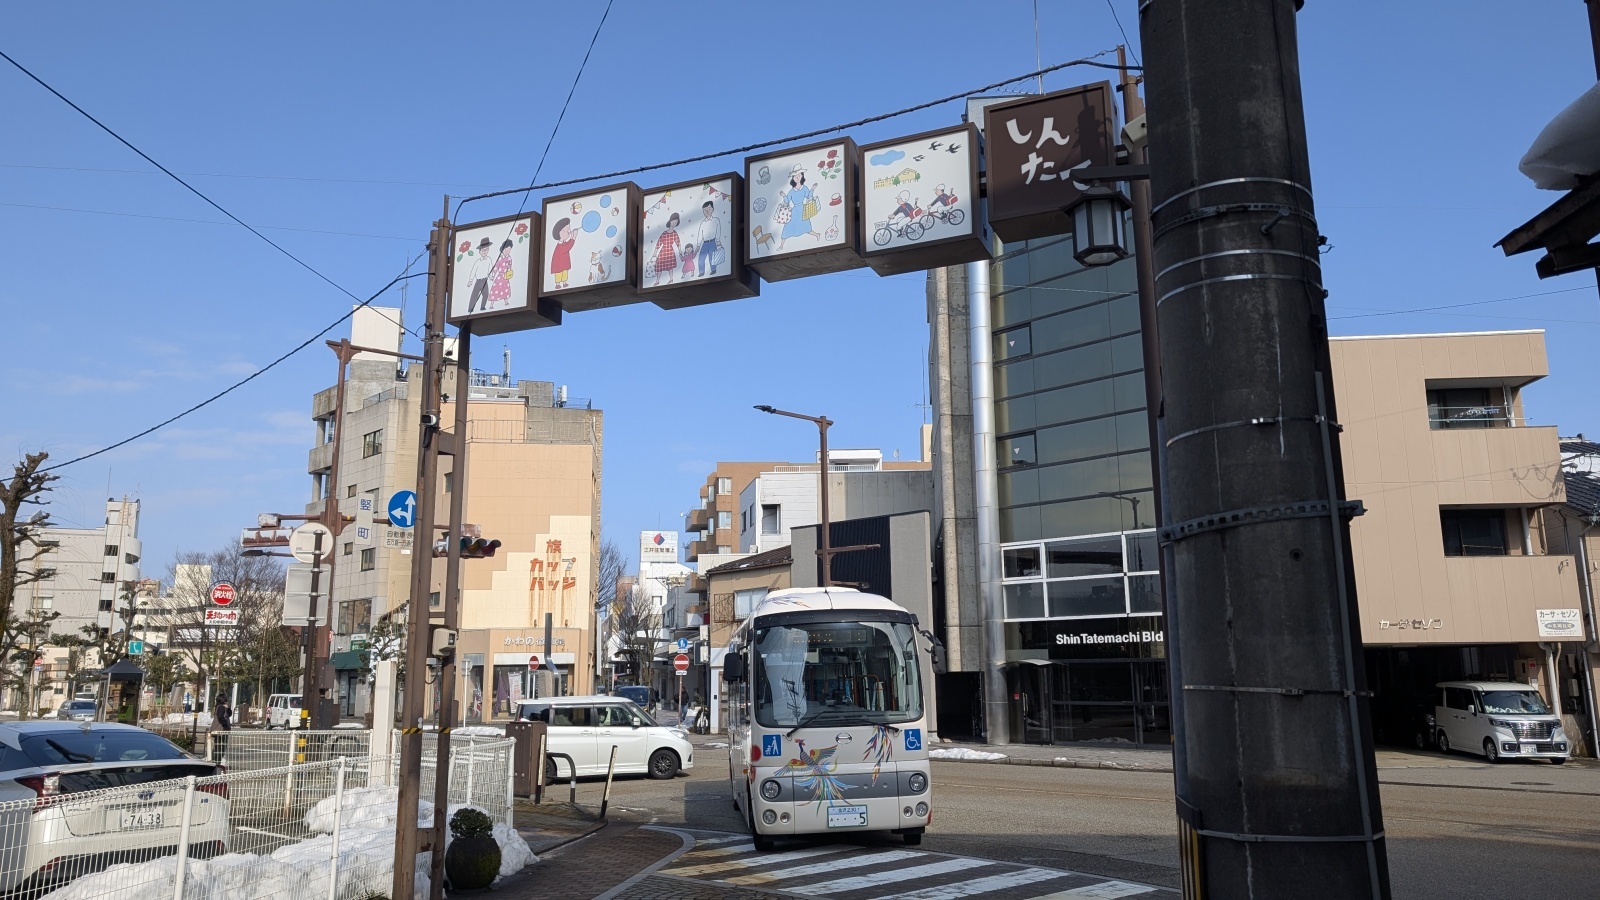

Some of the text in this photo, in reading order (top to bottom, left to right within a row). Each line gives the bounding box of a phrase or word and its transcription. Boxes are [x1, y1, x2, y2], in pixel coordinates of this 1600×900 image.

[1005, 116, 1070, 149] しん
[546, 538, 562, 554] 旗
[529, 556, 577, 572] カップ
[529, 576, 576, 591] バッジ
[213, 590, 234, 600] 消火栓
[1055, 633, 1080, 645] Shin
[1080, 631, 1140, 644] Tatemachi
